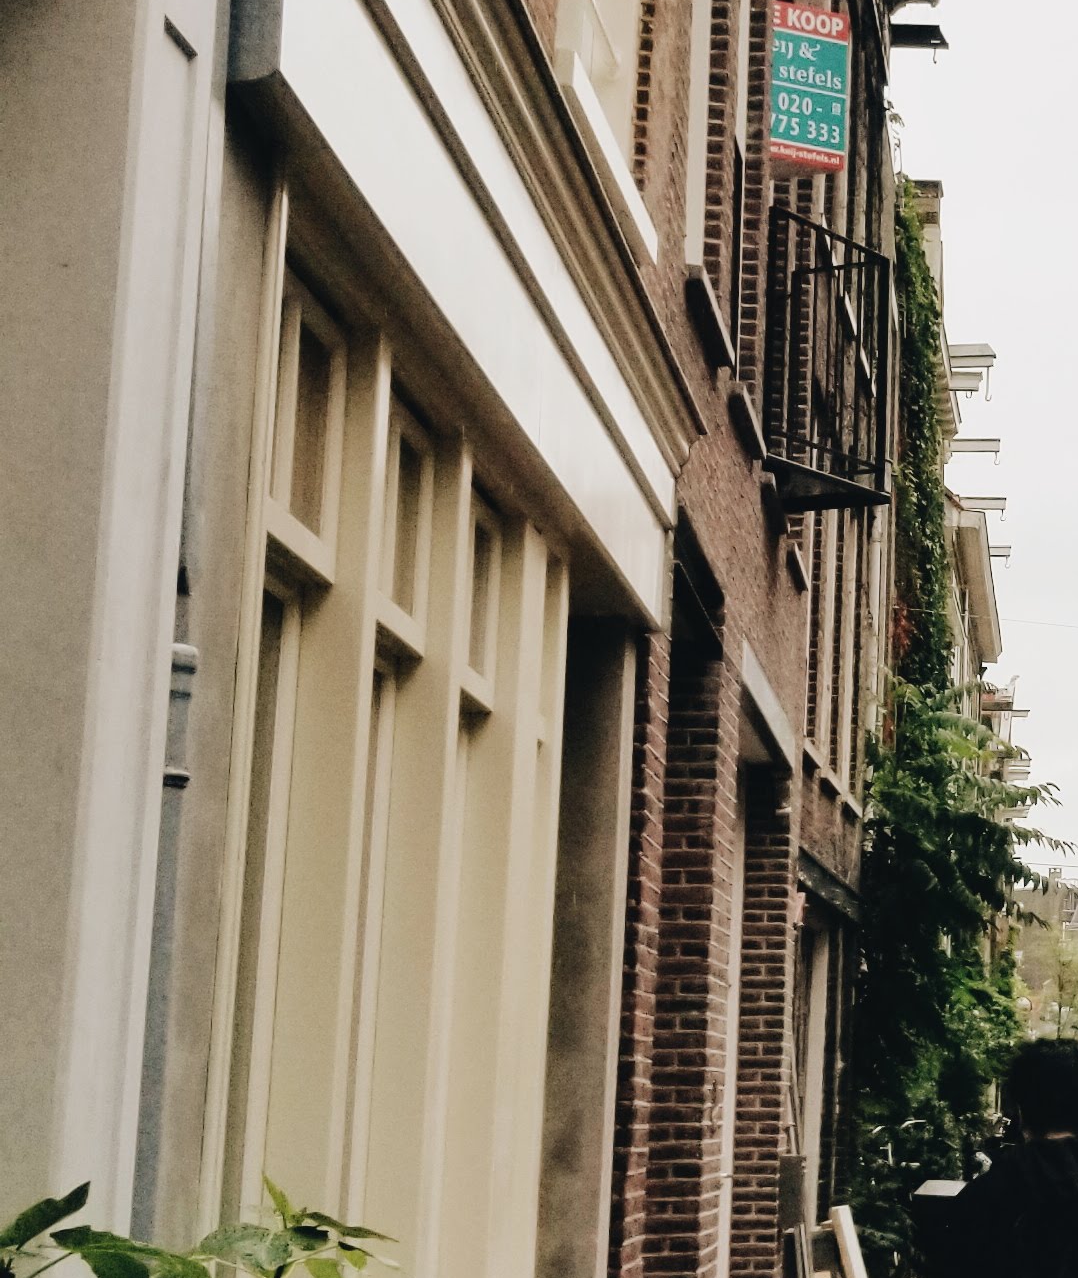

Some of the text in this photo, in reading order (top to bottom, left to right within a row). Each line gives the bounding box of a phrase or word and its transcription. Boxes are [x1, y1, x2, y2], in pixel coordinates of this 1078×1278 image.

[787, 7, 844, 36] KOOP
[799, 42, 821, 61] &
[779, 65, 842, 90] stefels
[807, 120, 840, 144] 333
